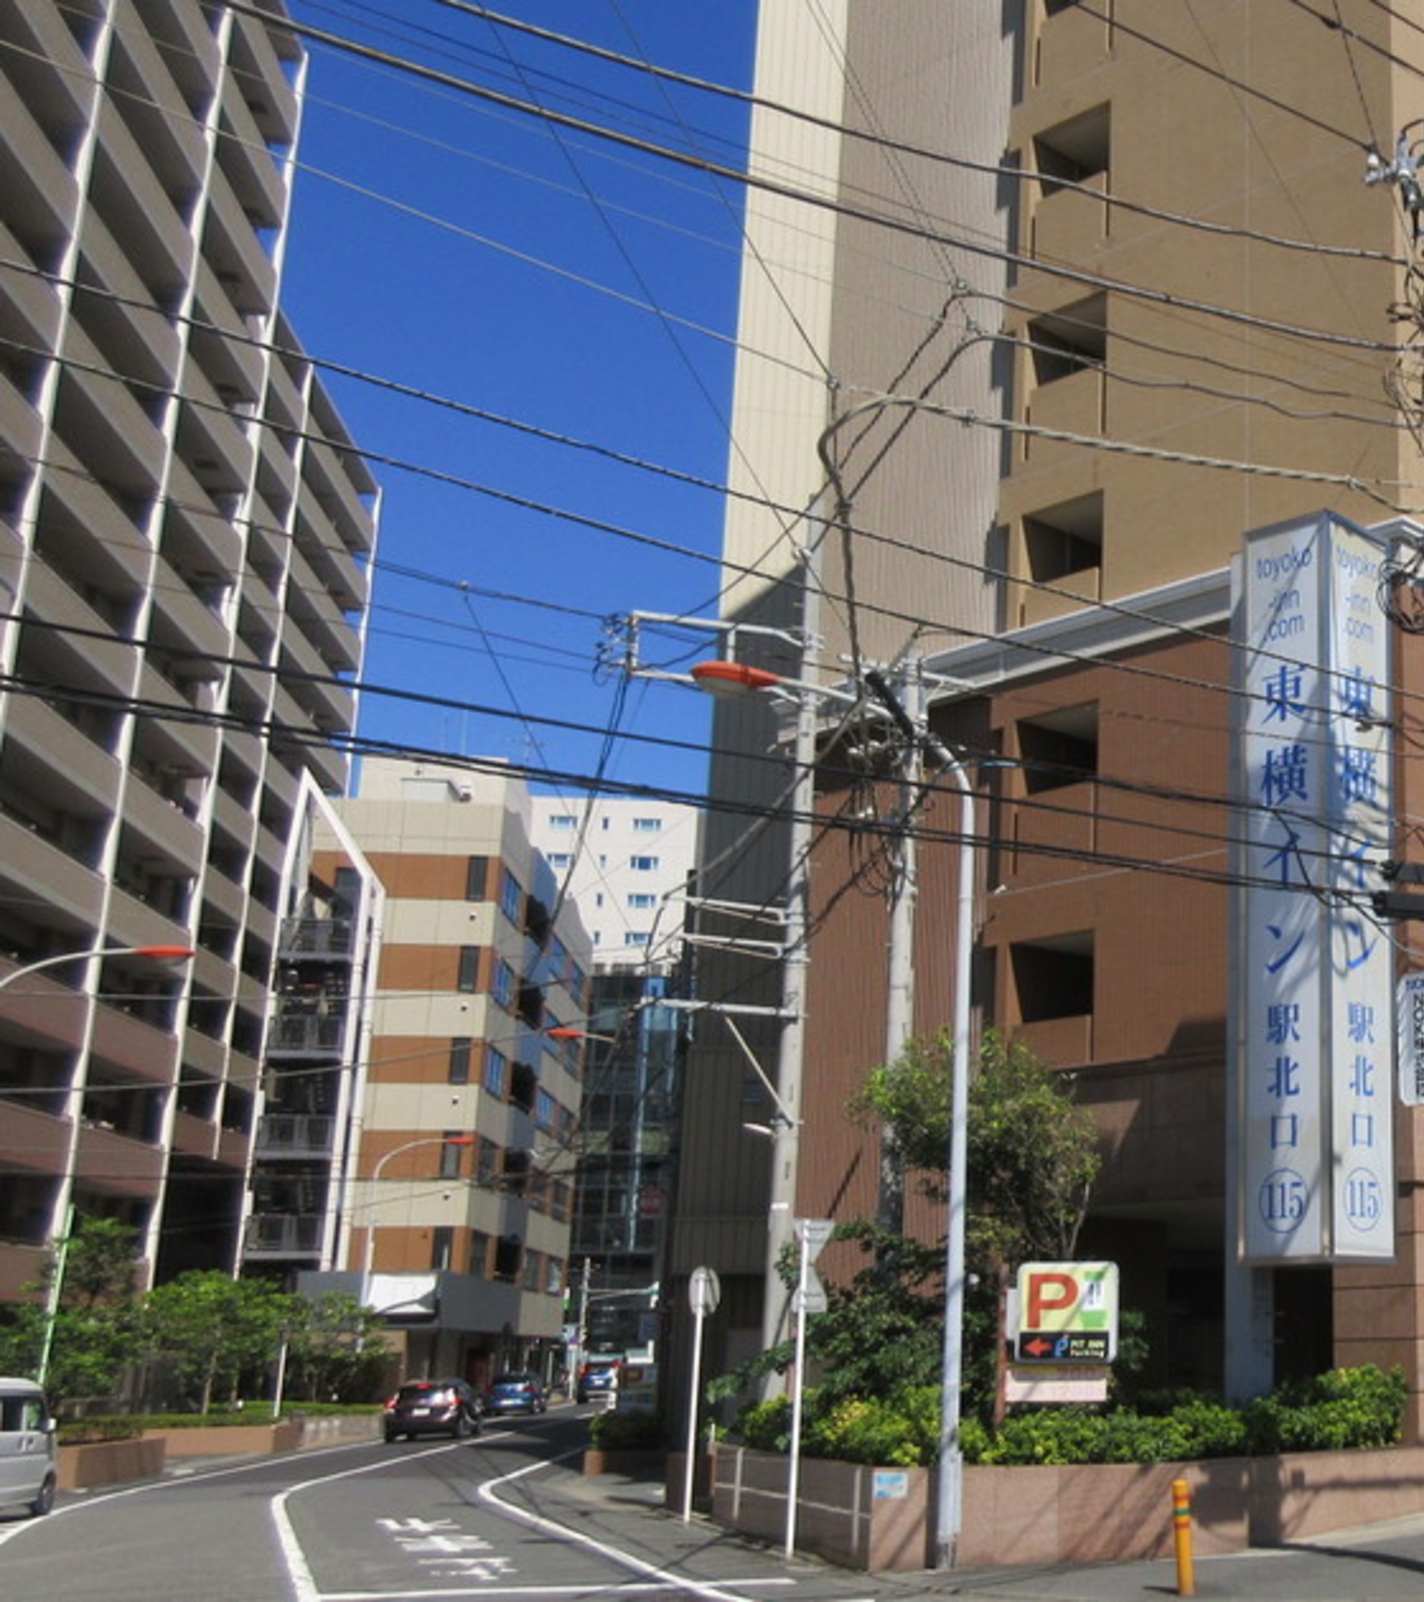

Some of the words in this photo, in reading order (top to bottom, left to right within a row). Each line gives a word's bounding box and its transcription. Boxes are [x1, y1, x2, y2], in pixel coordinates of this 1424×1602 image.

[1256, 548, 1313, 579] toyoko
[1266, 1003, 1300, 1149] 駅北口
[1346, 1001, 1374, 1148] 駅北口
[1264, 1181, 1304, 1221] 115
[1345, 1181, 1378, 1221] 115
[1027, 1273, 1079, 1330] P
